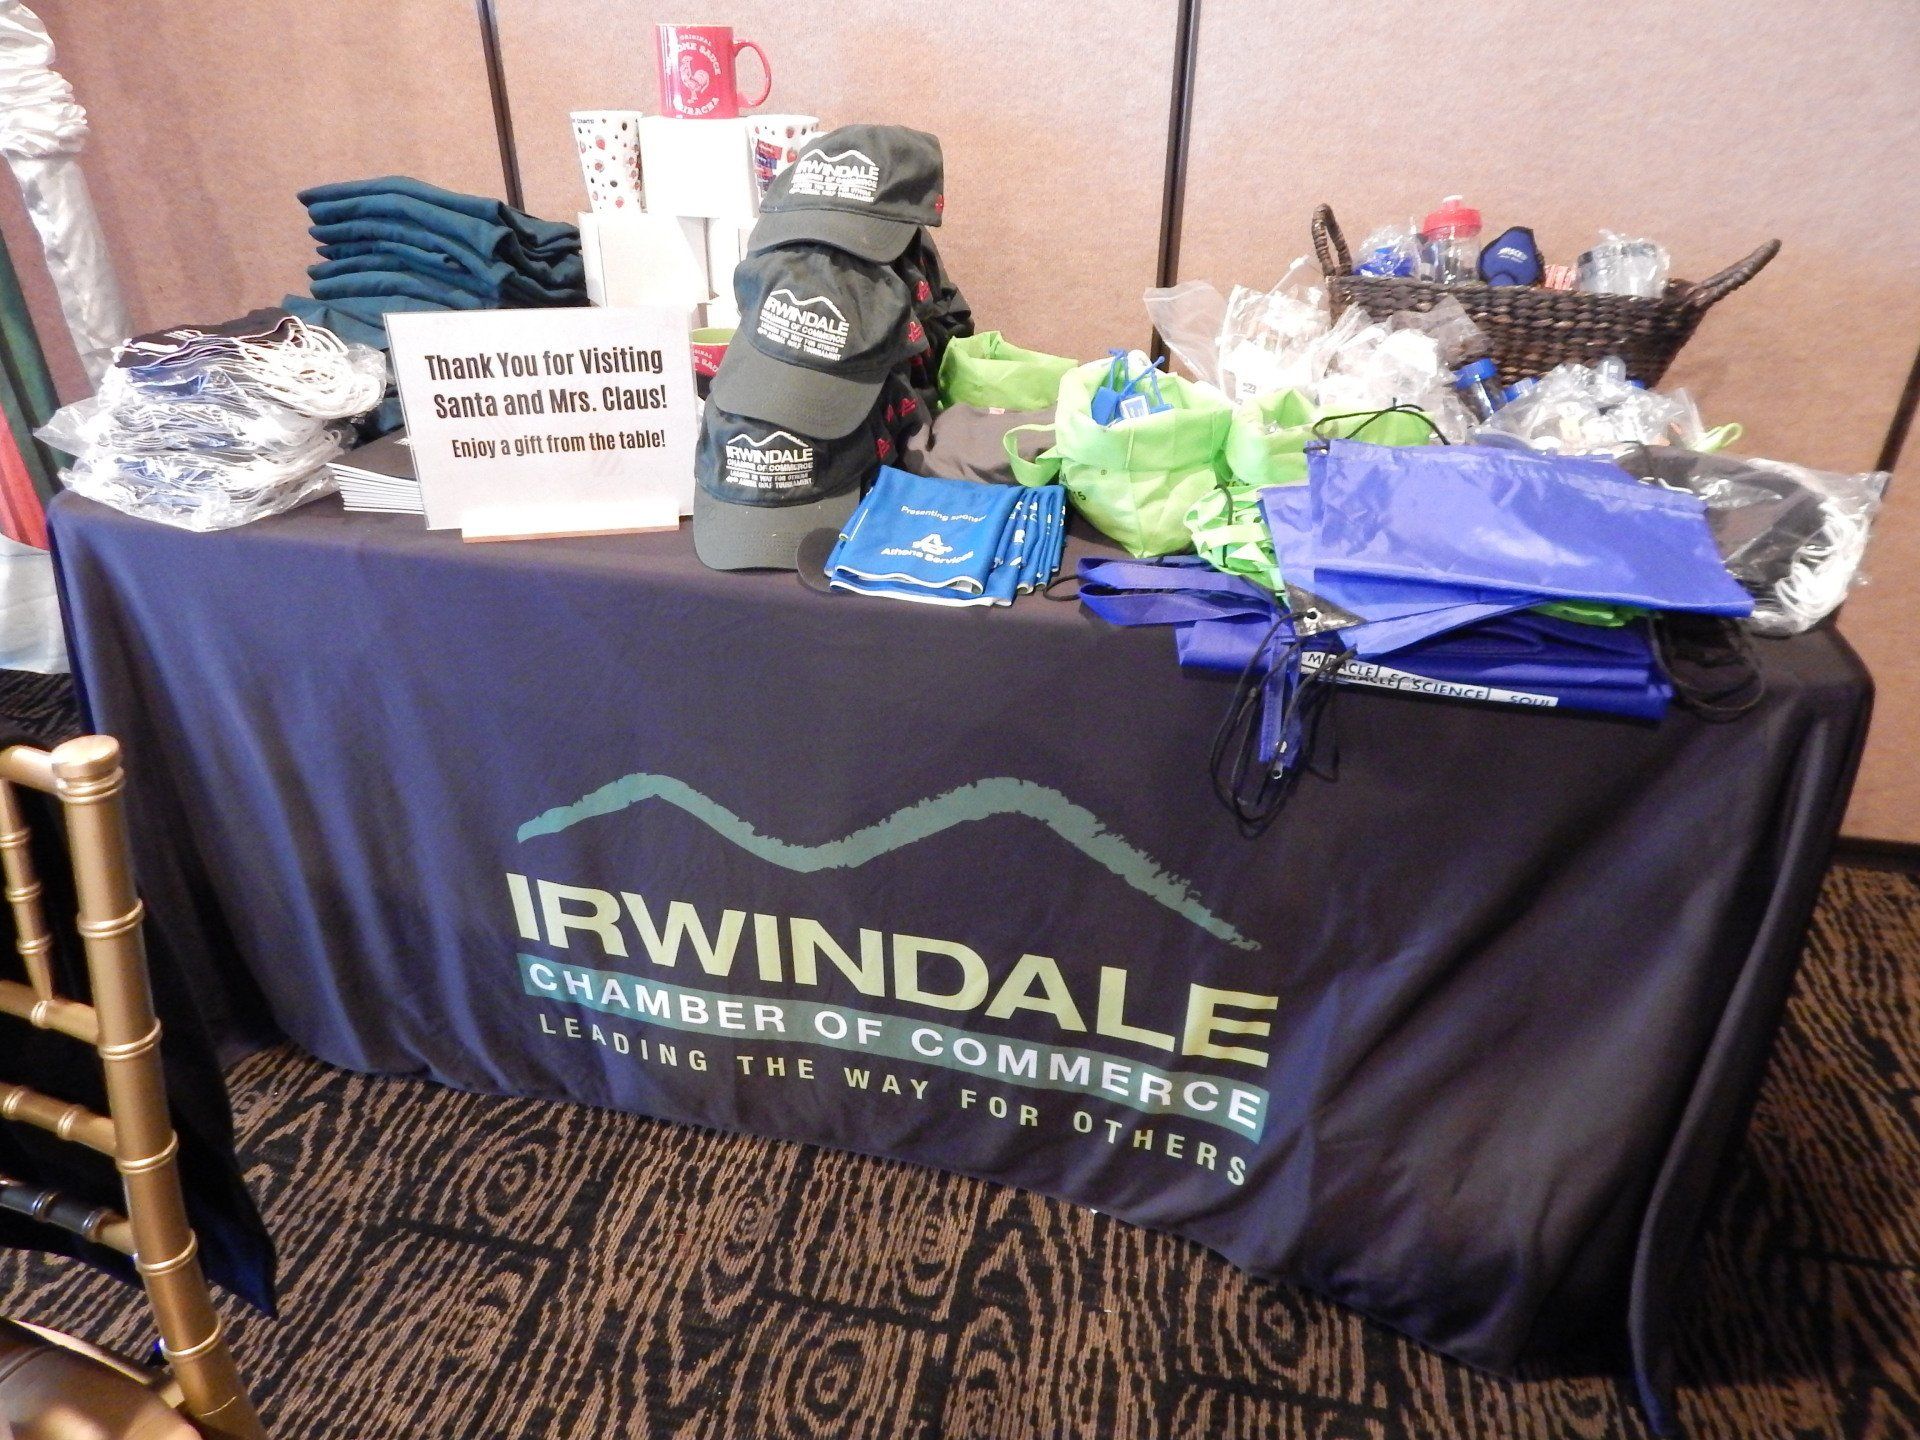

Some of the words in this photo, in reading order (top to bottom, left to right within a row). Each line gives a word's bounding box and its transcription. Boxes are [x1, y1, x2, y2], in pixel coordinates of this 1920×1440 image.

[764, 296, 849, 337] IRWINDALE
[425, 353, 494, 380] Thank
[497, 352, 538, 377] You
[543, 350, 574, 375] for
[579, 346, 663, 374] Visiting
[434, 393, 498, 419] Santa
[504, 390, 544, 415] and
[550, 388, 597, 413] Mrs.
[602, 385, 668, 411] Claus!
[452, 438, 495, 458] Enjoy
[501, 440, 511, 455] a
[515, 435, 544, 457] gift
[547, 434, 586, 453] from
[589, 432, 616, 450] the
[619, 429, 666, 450] table!
[726, 445, 814, 464] IRWINDALE
[901, 506, 949, 521] Presenting
[1412, 680, 1484, 699] SCIENCE
[506, 872, 1279, 1068] IRWINDALE
[529, 963, 785, 1033] CHAMBER
[814, 1010, 883, 1044] OF
[911, 1028, 1261, 1130] COMMERCE
[540, 1013, 707, 1071] LEADING
[737, 1055, 815, 1079] THE
[844, 1067, 929, 1099] WAY
[961, 1089, 1039, 1127] FOR
[1073, 1111, 1246, 1186] OTHERS
